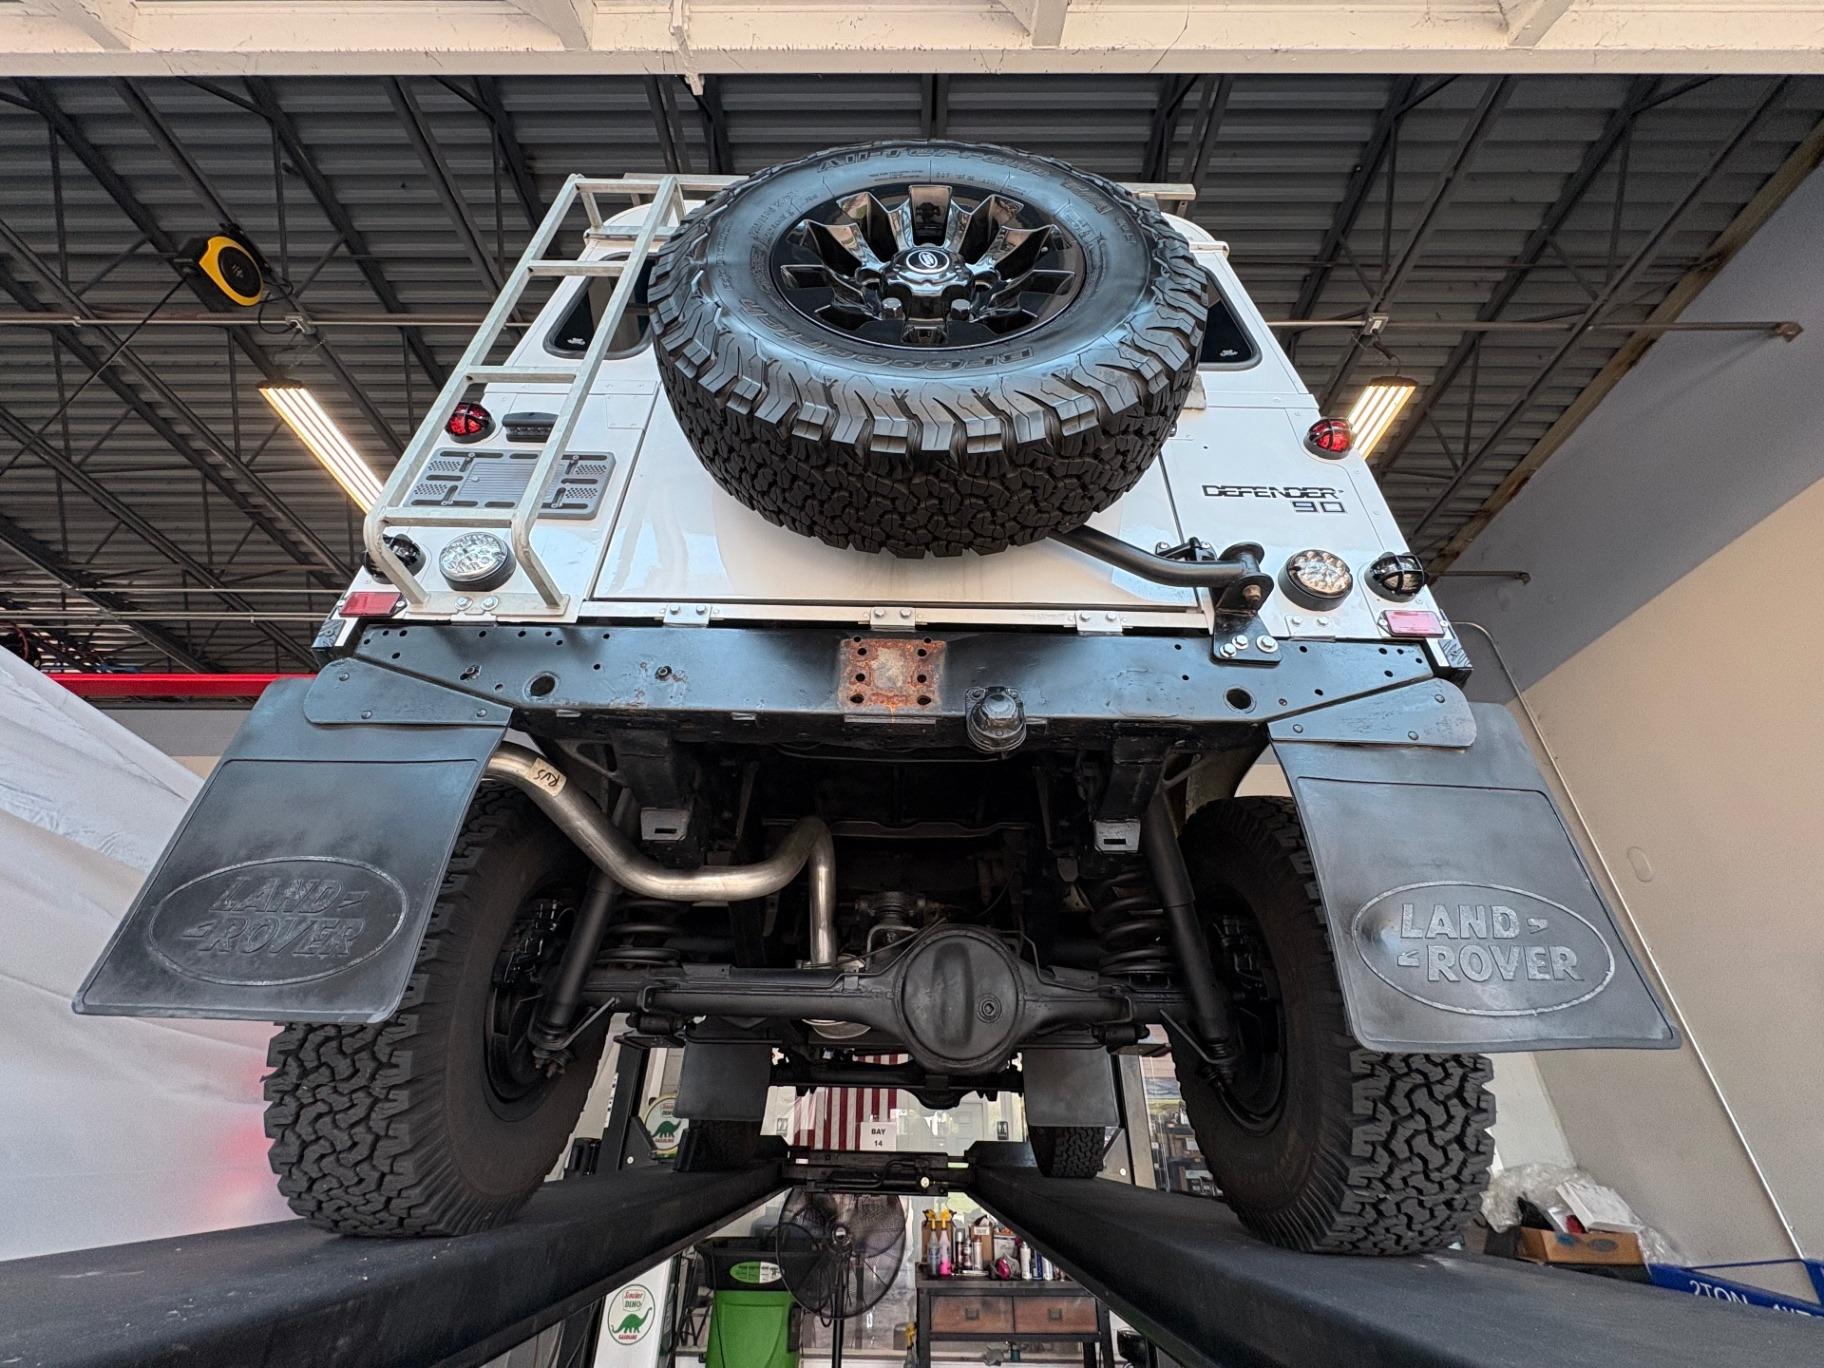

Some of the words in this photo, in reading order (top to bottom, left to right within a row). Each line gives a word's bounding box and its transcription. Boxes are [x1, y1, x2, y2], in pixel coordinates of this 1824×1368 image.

[1202, 484, 1340, 500] DEFENDER
[1291, 501, 1346, 513] 90
[197, 916, 366, 957] ROVER
[1400, 903, 1520, 940] LAND
[1426, 944, 1585, 982] ROVER
